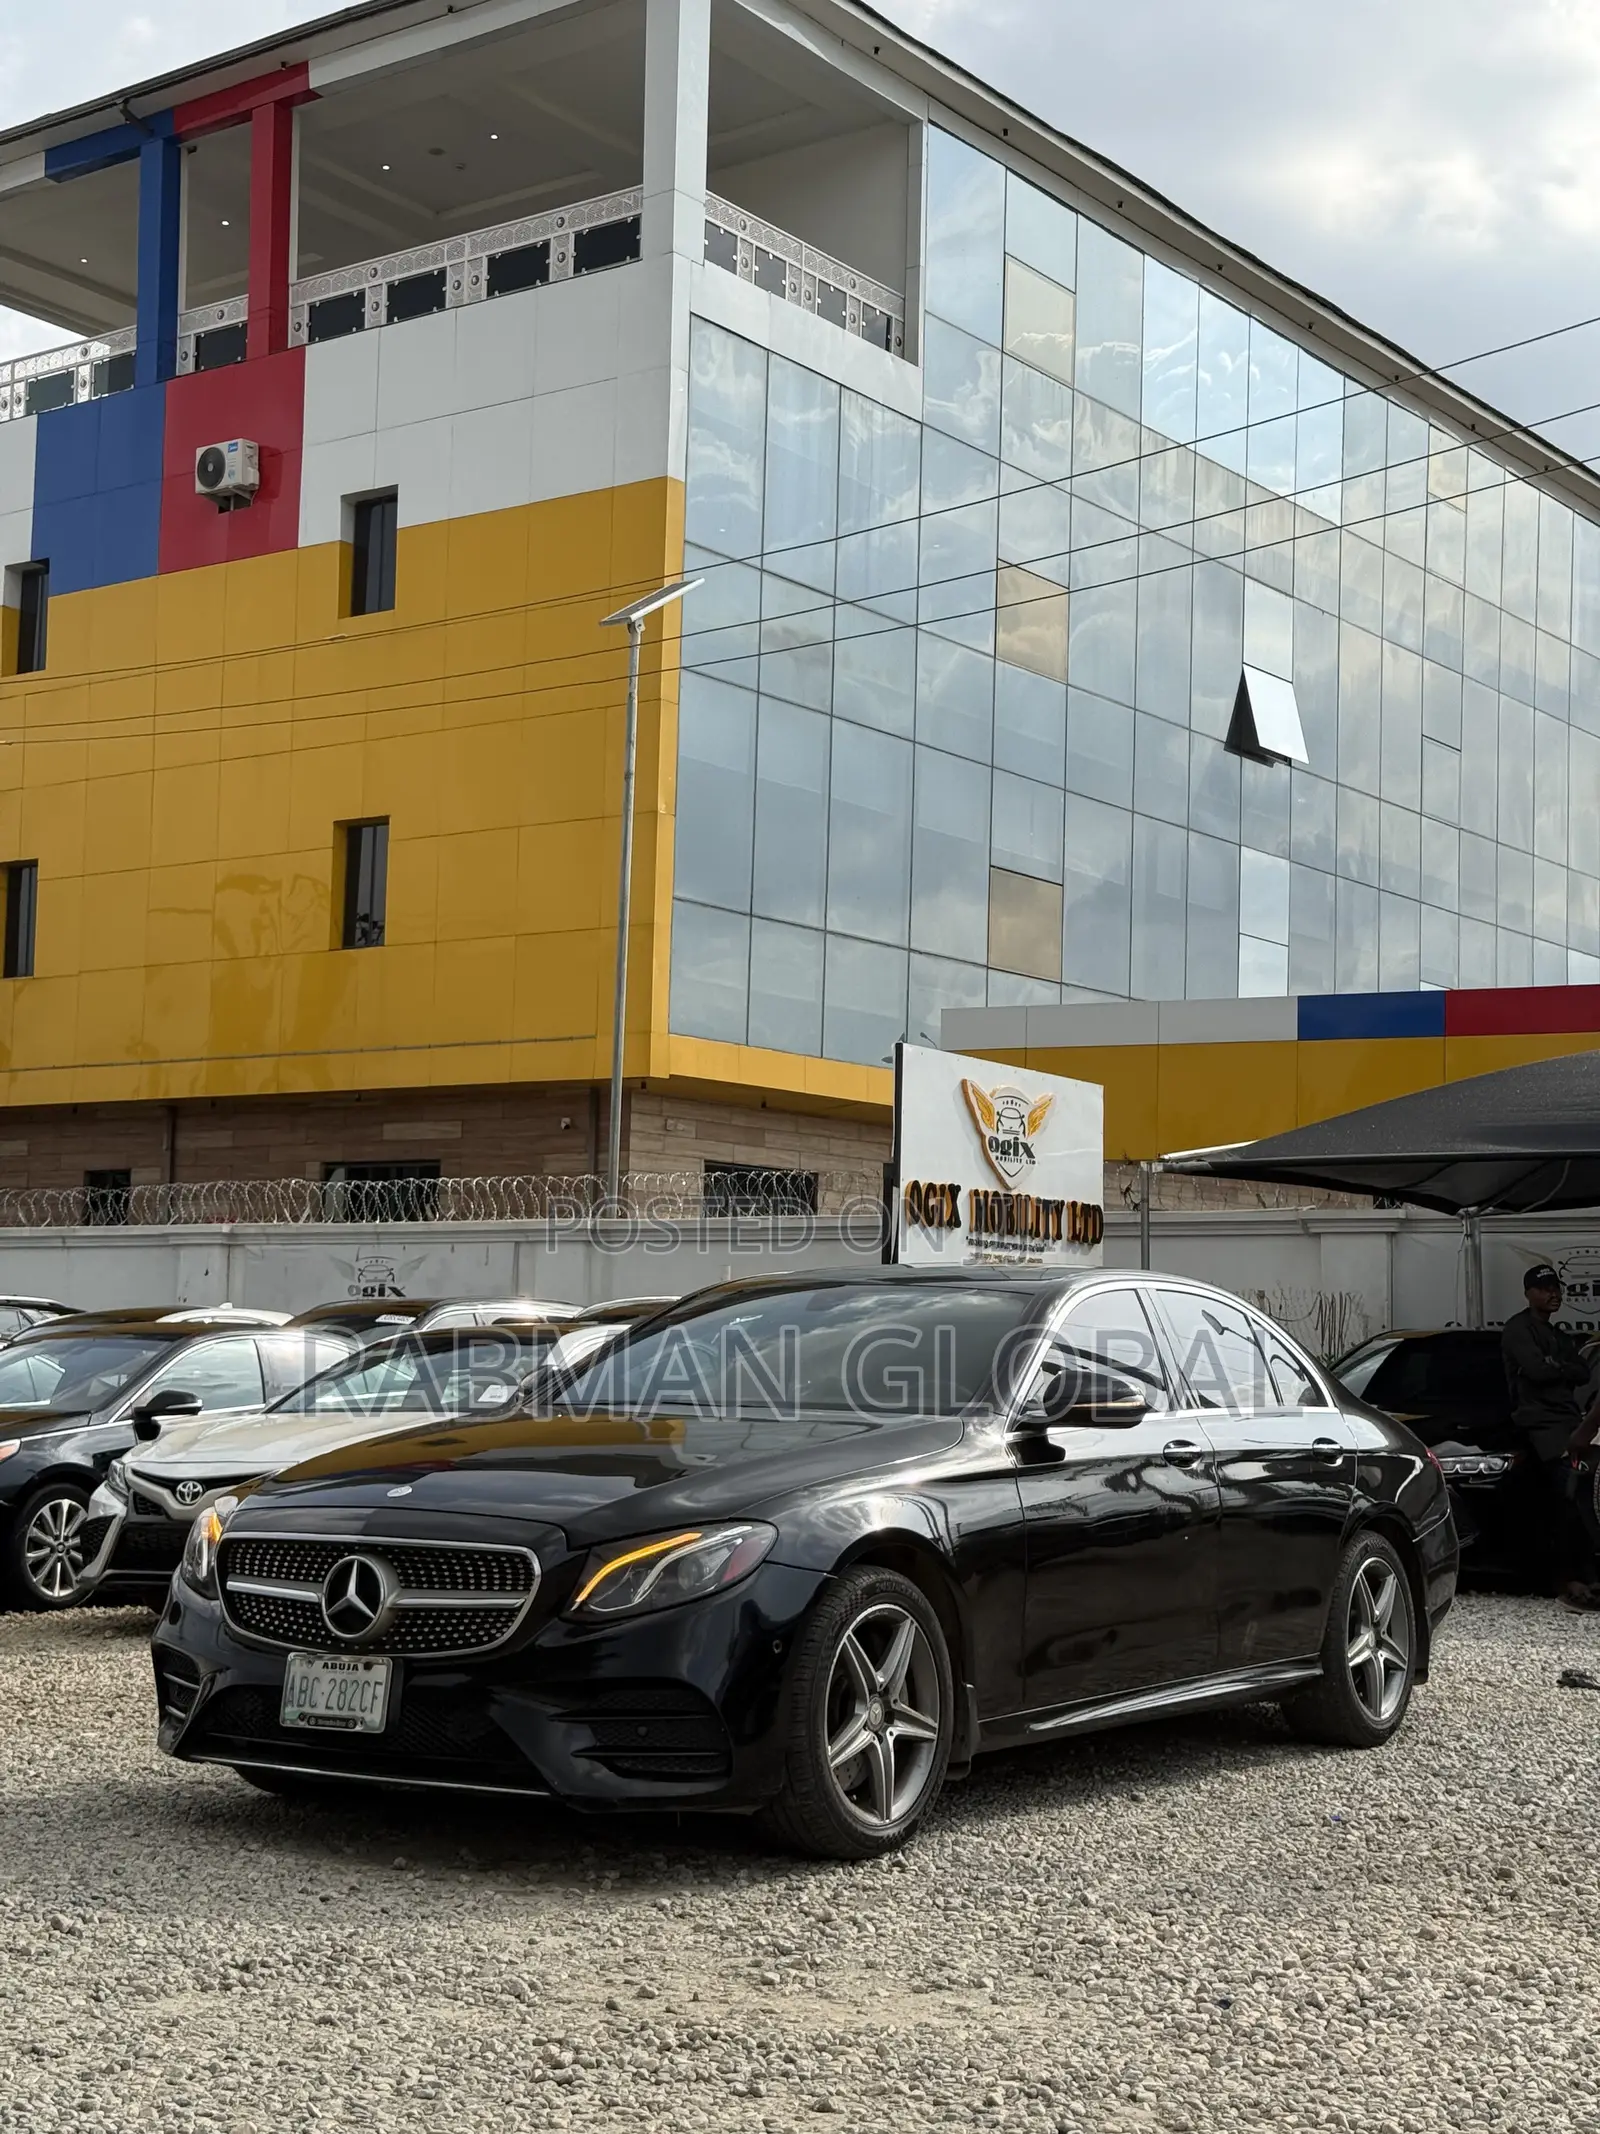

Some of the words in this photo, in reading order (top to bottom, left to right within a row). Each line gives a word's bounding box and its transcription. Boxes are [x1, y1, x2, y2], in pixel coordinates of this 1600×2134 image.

[905, 1179, 961, 1228] OGIX
[969, 1188, 1065, 1241] MOBILITY
[1066, 1200, 1104, 1245] LTD
[322, 1661, 359, 1671] ABUJA
